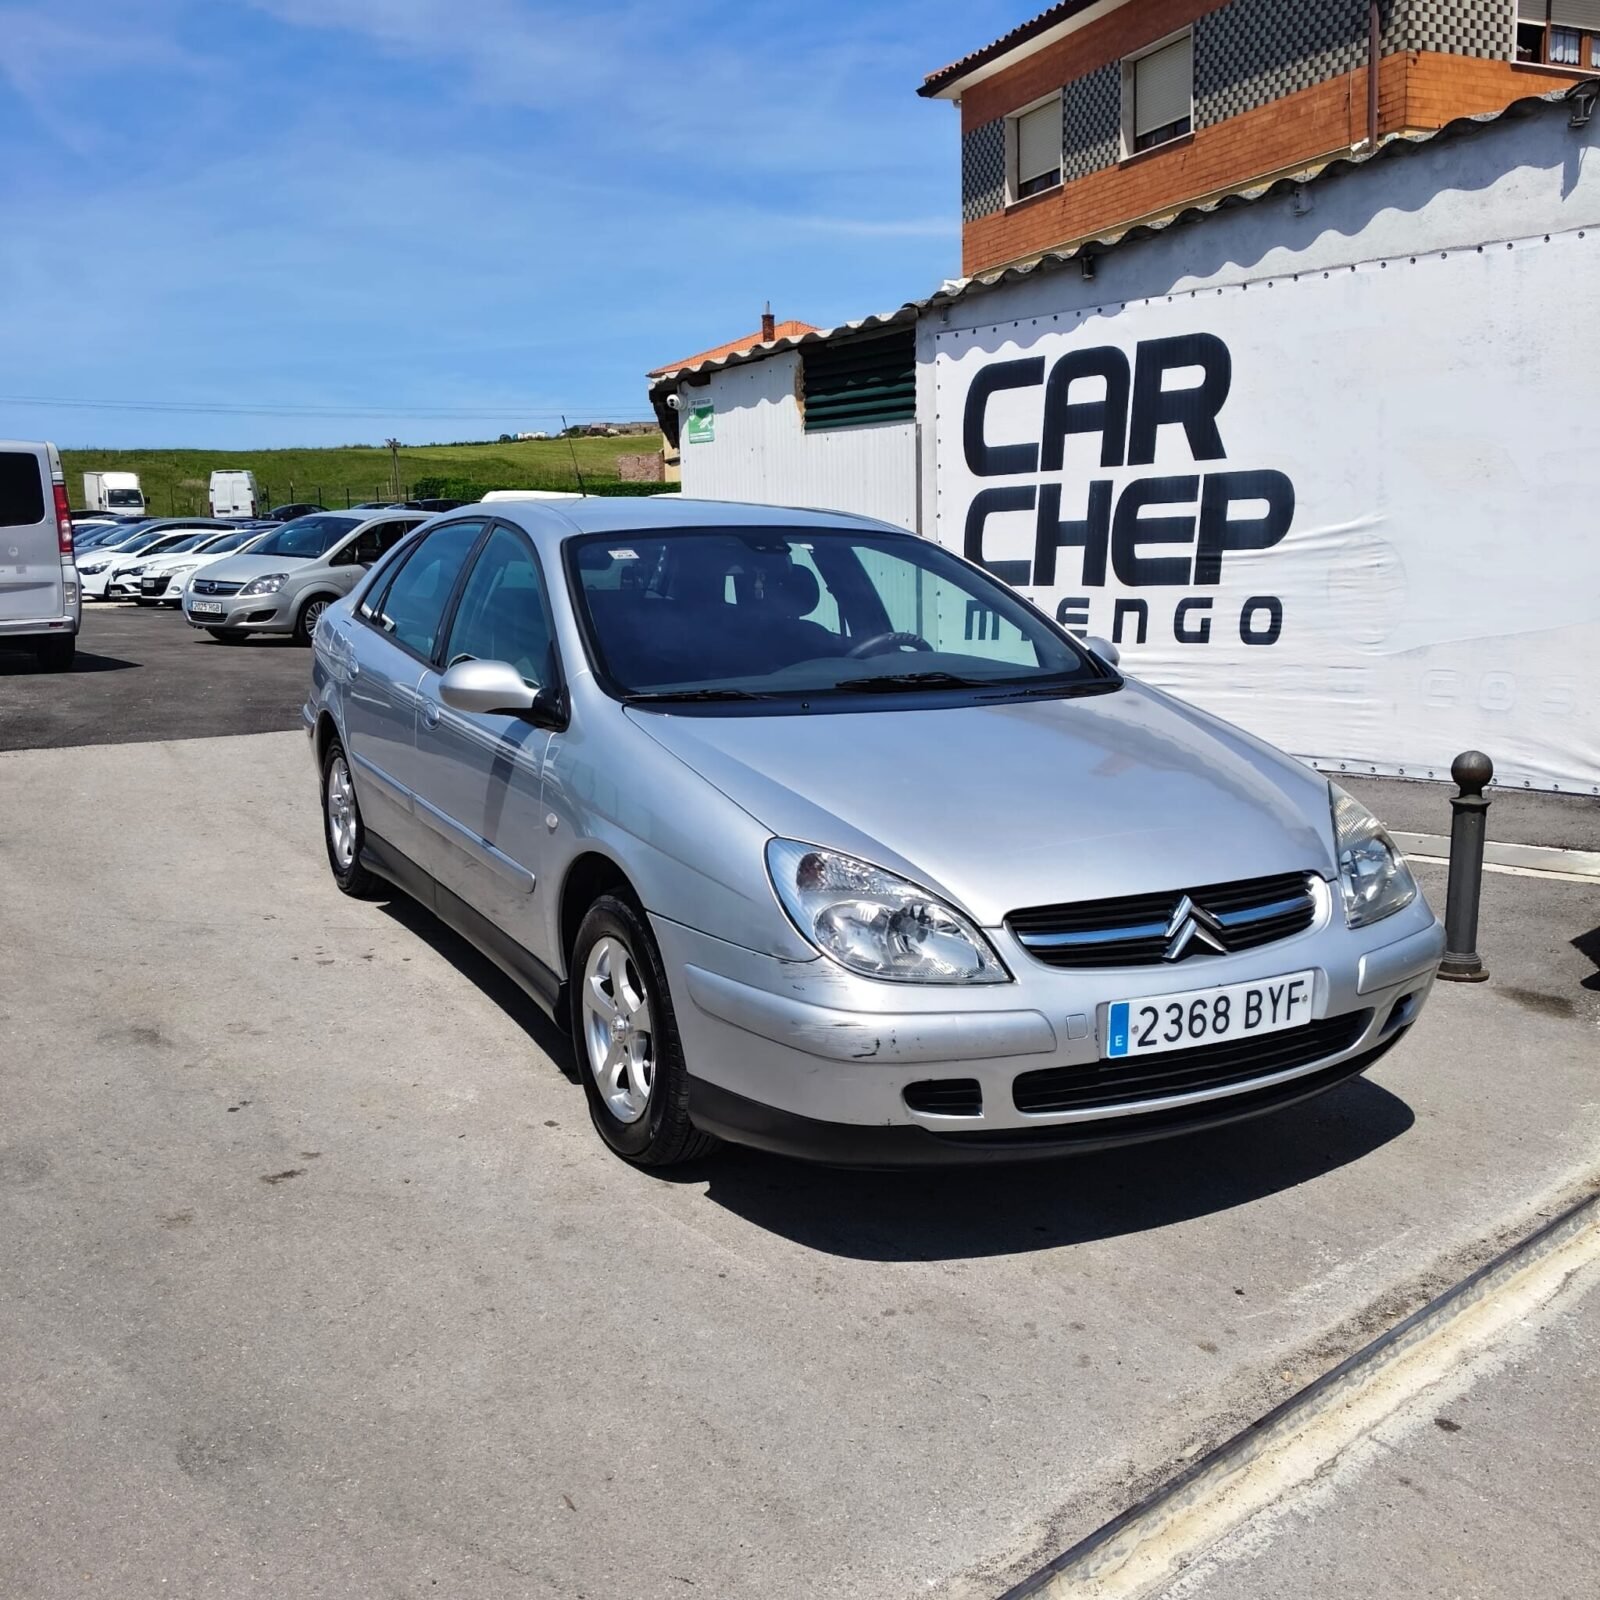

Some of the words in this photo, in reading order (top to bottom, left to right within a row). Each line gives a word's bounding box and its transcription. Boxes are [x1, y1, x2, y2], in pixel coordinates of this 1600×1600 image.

[963, 332, 1232, 476] CAR
[963, 469, 1296, 587] CHEP
[964, 595, 1283, 645] MENGO
[1115, 1035, 1123, 1047] E
[1137, 995, 1231, 1048] 2368
[1244, 980, 1304, 1030] BYF
